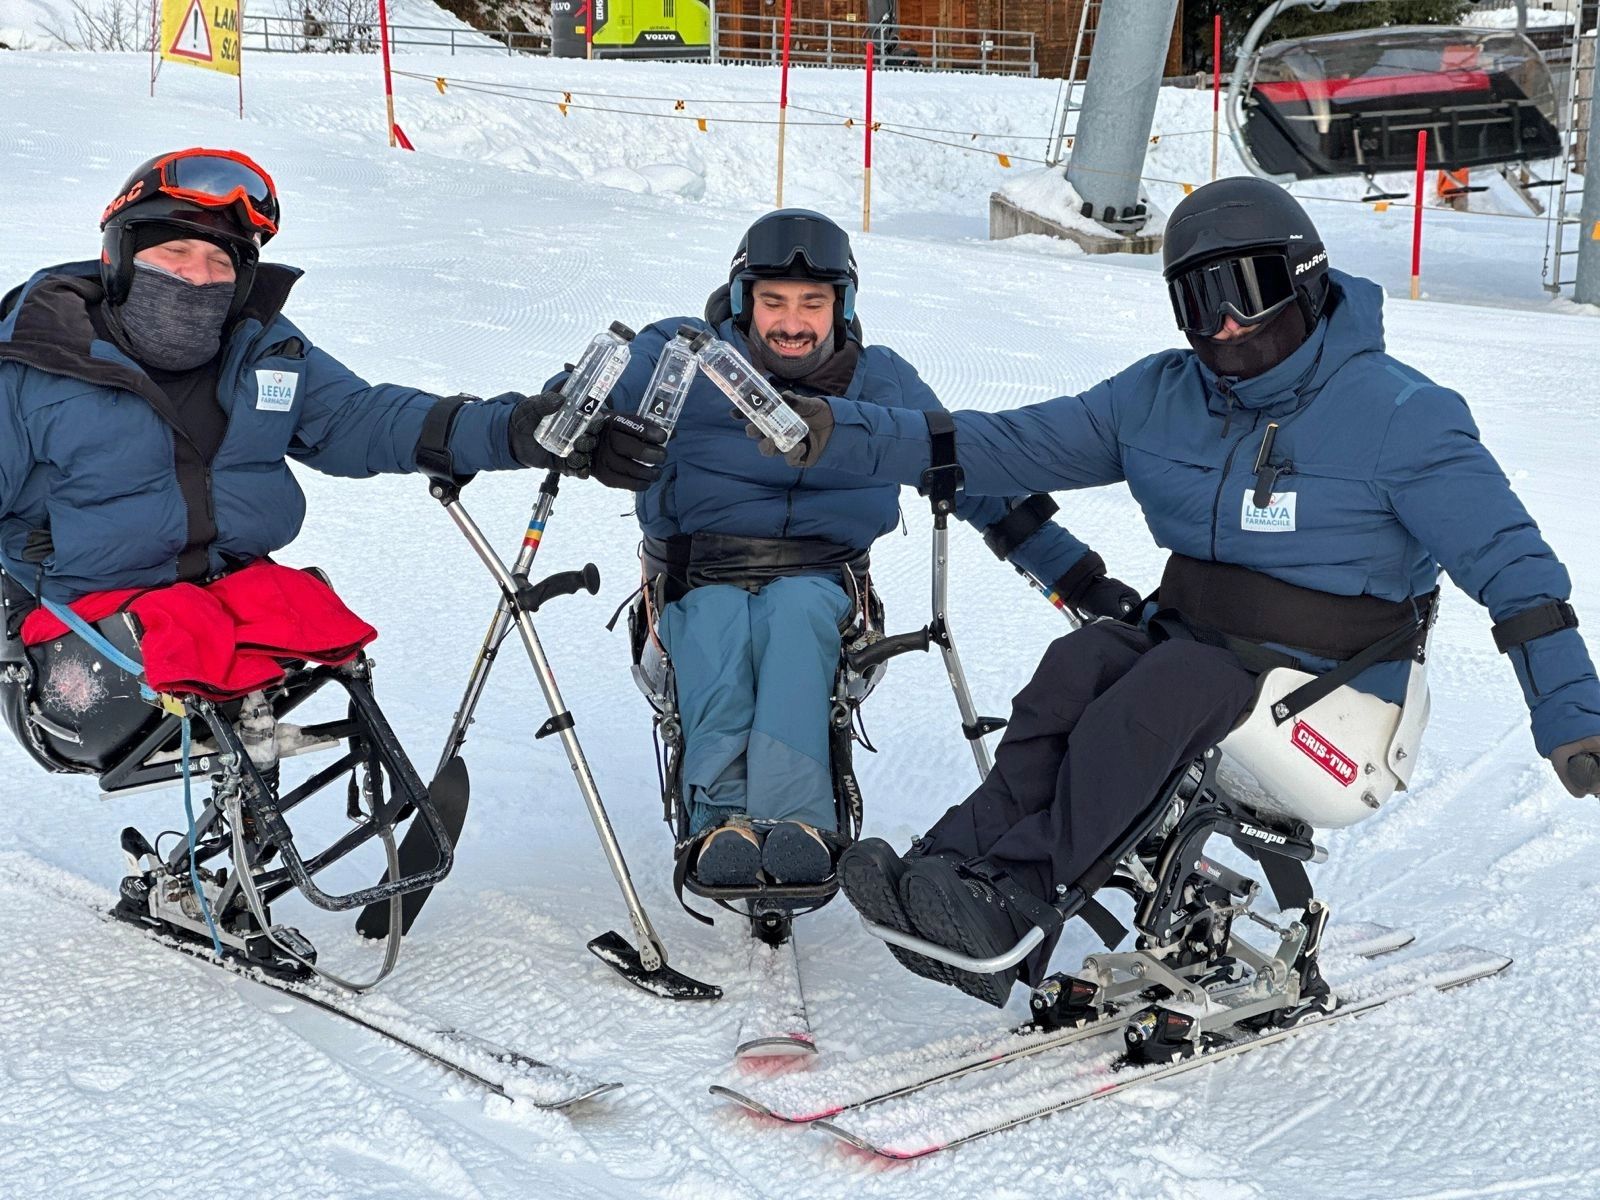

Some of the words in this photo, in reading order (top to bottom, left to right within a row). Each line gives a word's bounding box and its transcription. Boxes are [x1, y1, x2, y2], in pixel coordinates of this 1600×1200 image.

[214, 5, 238, 32] LAN
[644, 33, 676, 41] VOLVO
[221, 37, 238, 61] SLO
[261, 384, 292, 399] LEEVA
[613, 415, 645, 433] reusch
[1246, 505, 1290, 519] LEEVA
[1297, 728, 1353, 779] CRIS-TIM
[1239, 822, 1287, 845] Tempo
